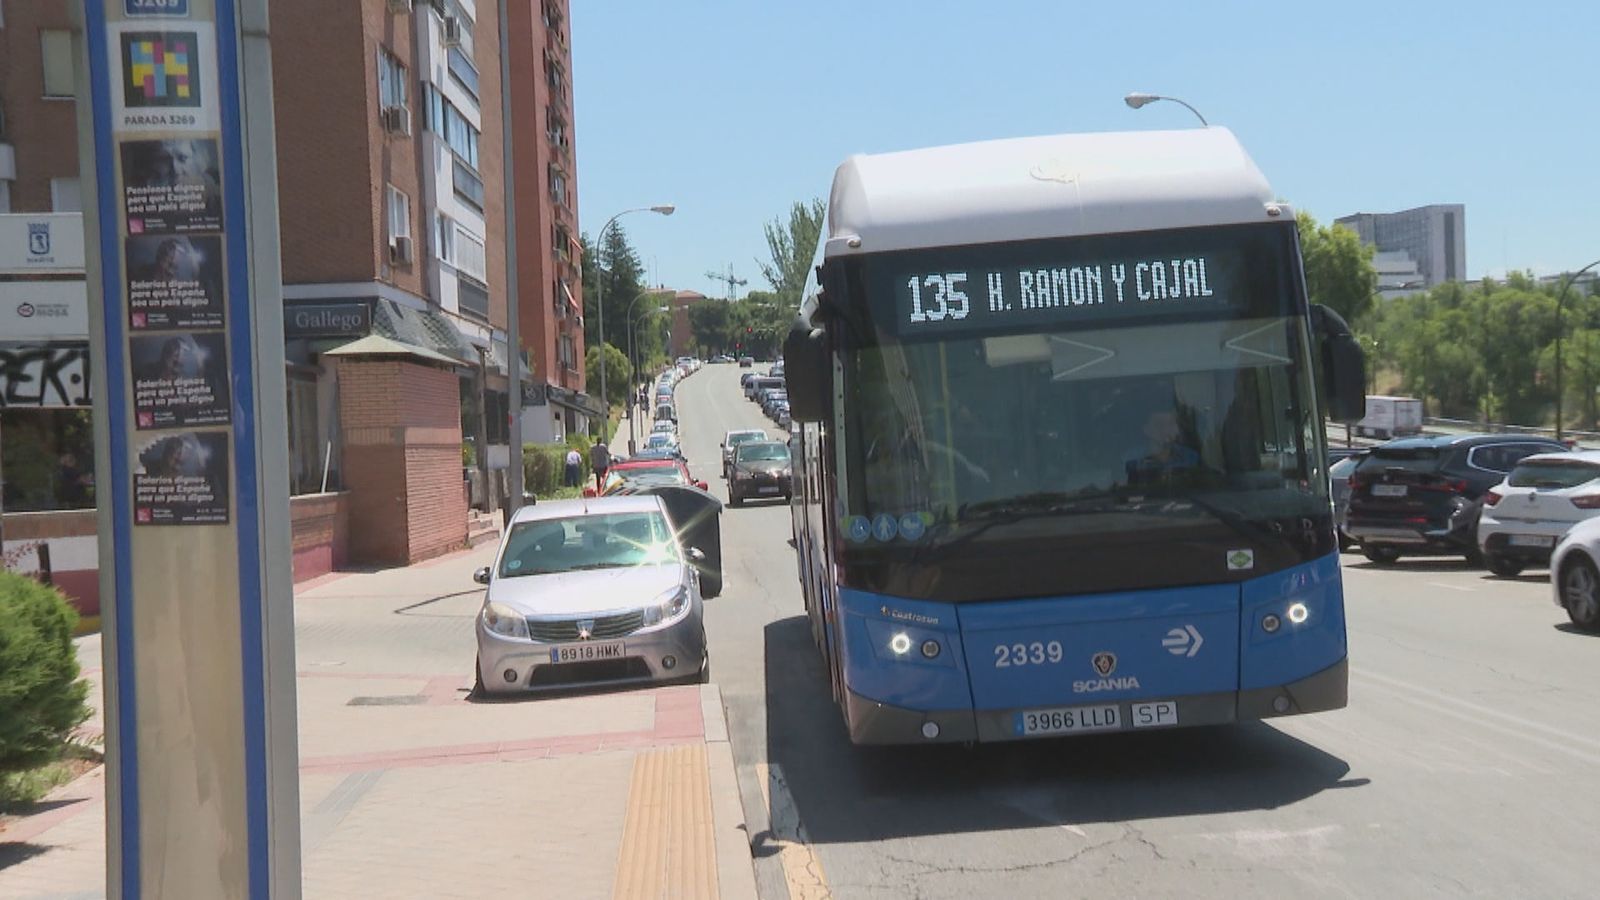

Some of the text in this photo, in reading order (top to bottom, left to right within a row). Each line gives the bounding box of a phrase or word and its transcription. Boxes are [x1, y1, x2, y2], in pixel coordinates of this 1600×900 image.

[125, 115, 196, 125] PARADA 3269
[145, 203, 157, 211] un
[149, 194, 165, 204] que
[152, 289, 169, 298] que
[908, 258, 1213, 323] 135 H. RAMON Y CAJAL
[296, 311, 361, 330] Gallego
[561, 644, 620, 660] 8918 HMK
[994, 640, 1063, 668] 2339
[1072, 677, 1140, 693] SCANIA
[1027, 704, 1170, 732] 3966 LLD SP
